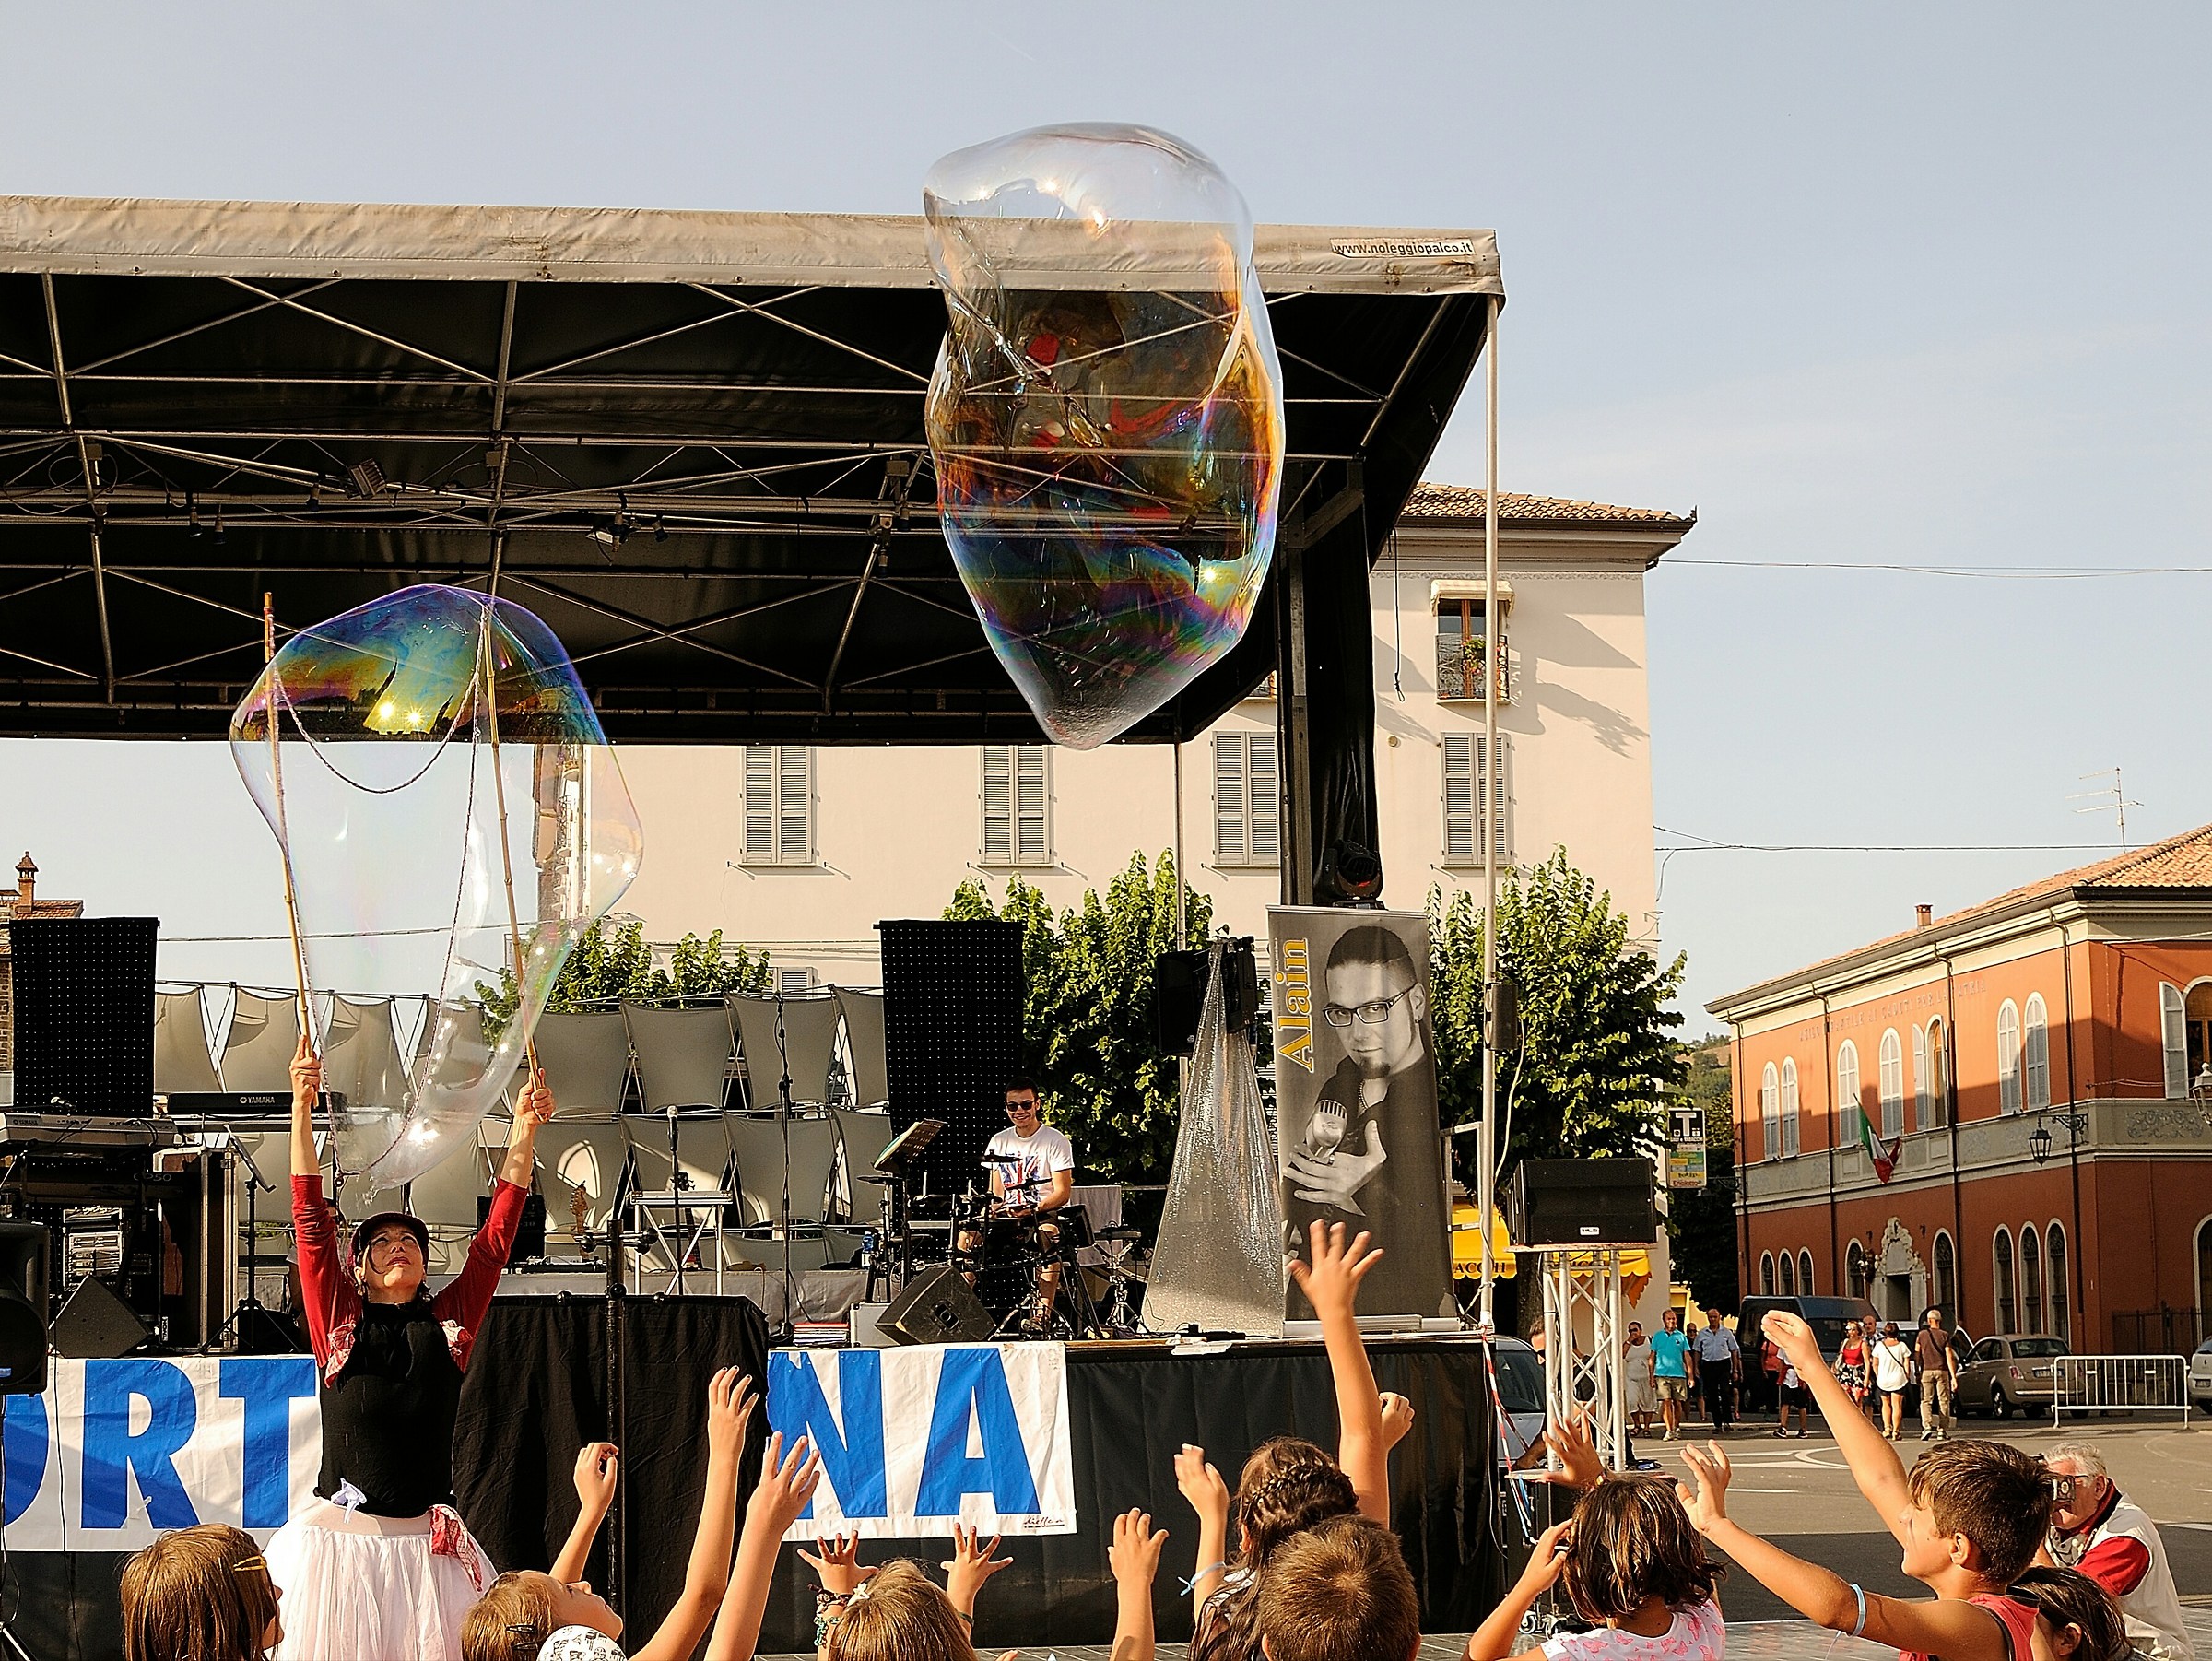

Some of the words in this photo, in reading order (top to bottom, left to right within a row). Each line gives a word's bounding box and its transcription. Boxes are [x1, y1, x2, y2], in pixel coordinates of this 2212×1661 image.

[1333, 241, 1473, 256] www.noleggiopalco.it
[1275, 938, 1314, 1073] Alain
[248, 1096, 276, 1104] YAMAHA
[1675, 1112, 1697, 1137] T
[766, 1349, 1041, 1518] NA
